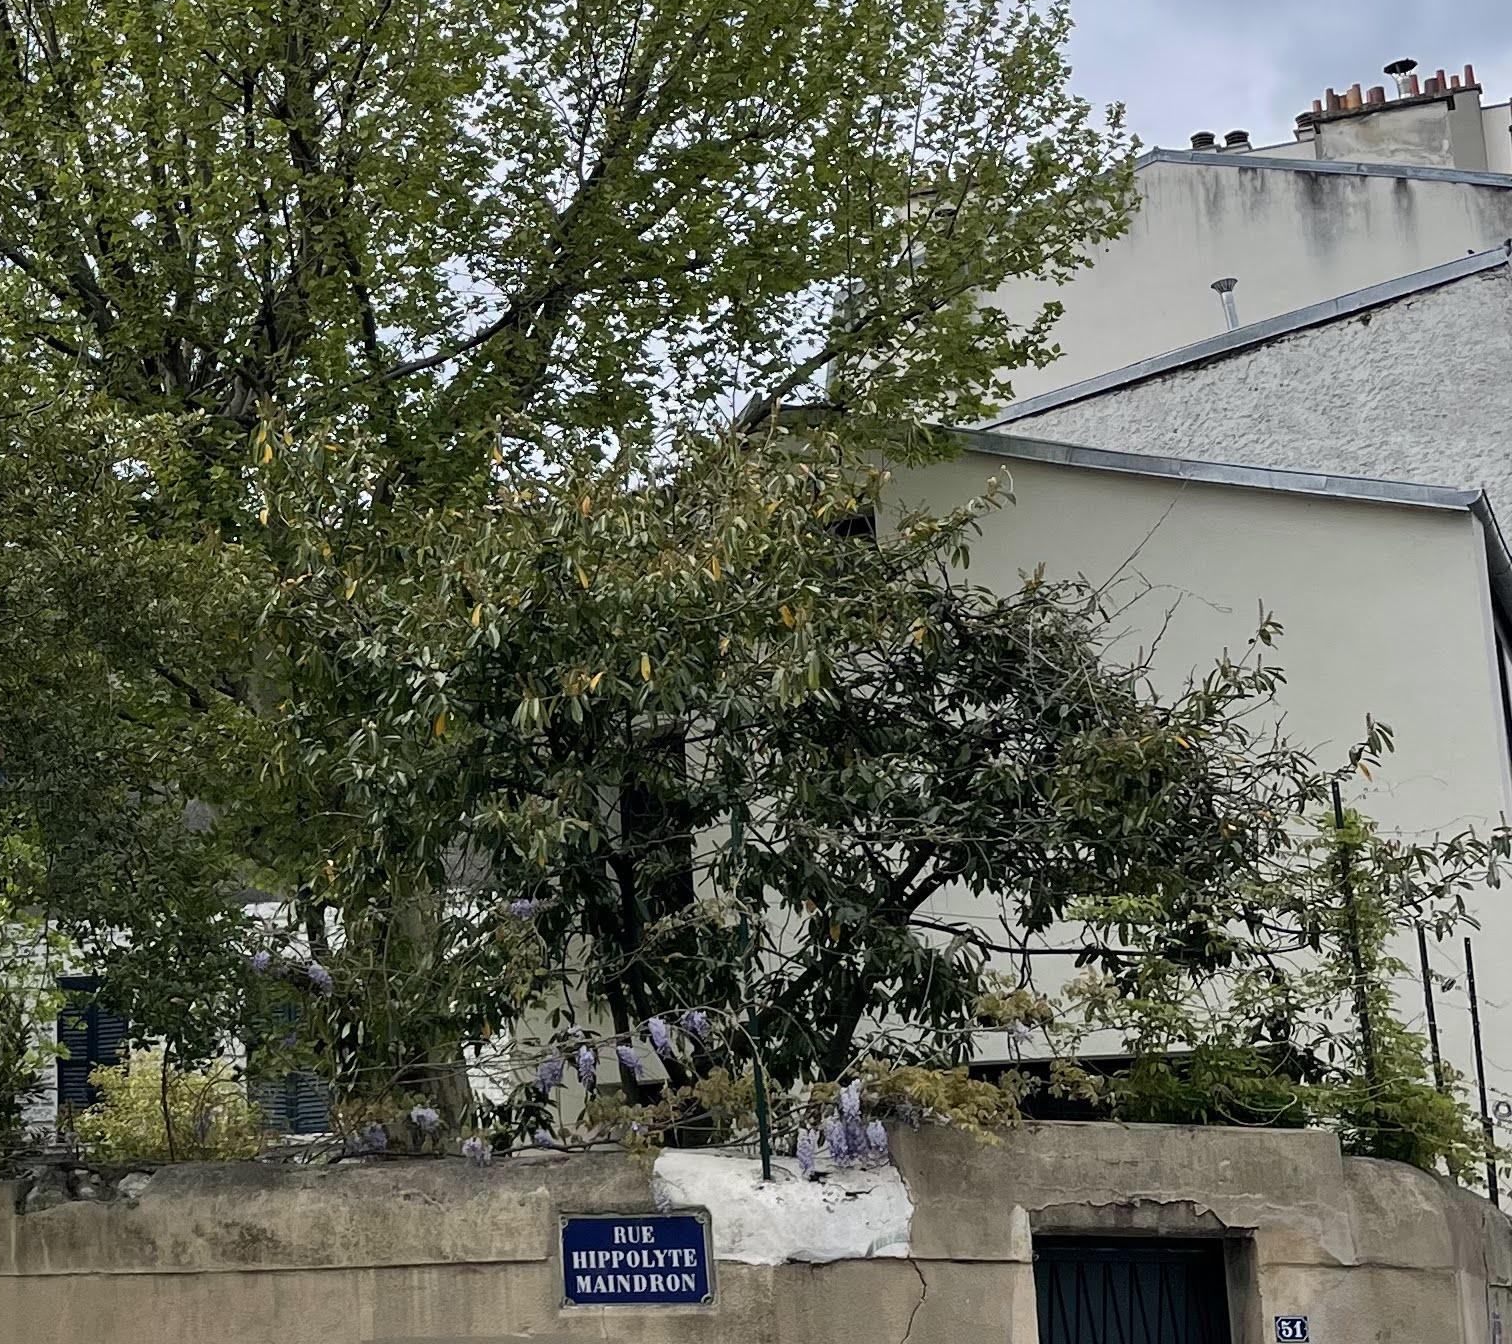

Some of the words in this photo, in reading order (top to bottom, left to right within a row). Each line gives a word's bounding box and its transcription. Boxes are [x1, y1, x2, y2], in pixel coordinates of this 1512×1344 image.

[613, 1225, 655, 1244] RUE
[572, 1248, 697, 1269] HIPPOLYTE
[576, 1273, 696, 1293] MAINDRON
[1281, 1320, 1303, 1338] 51
